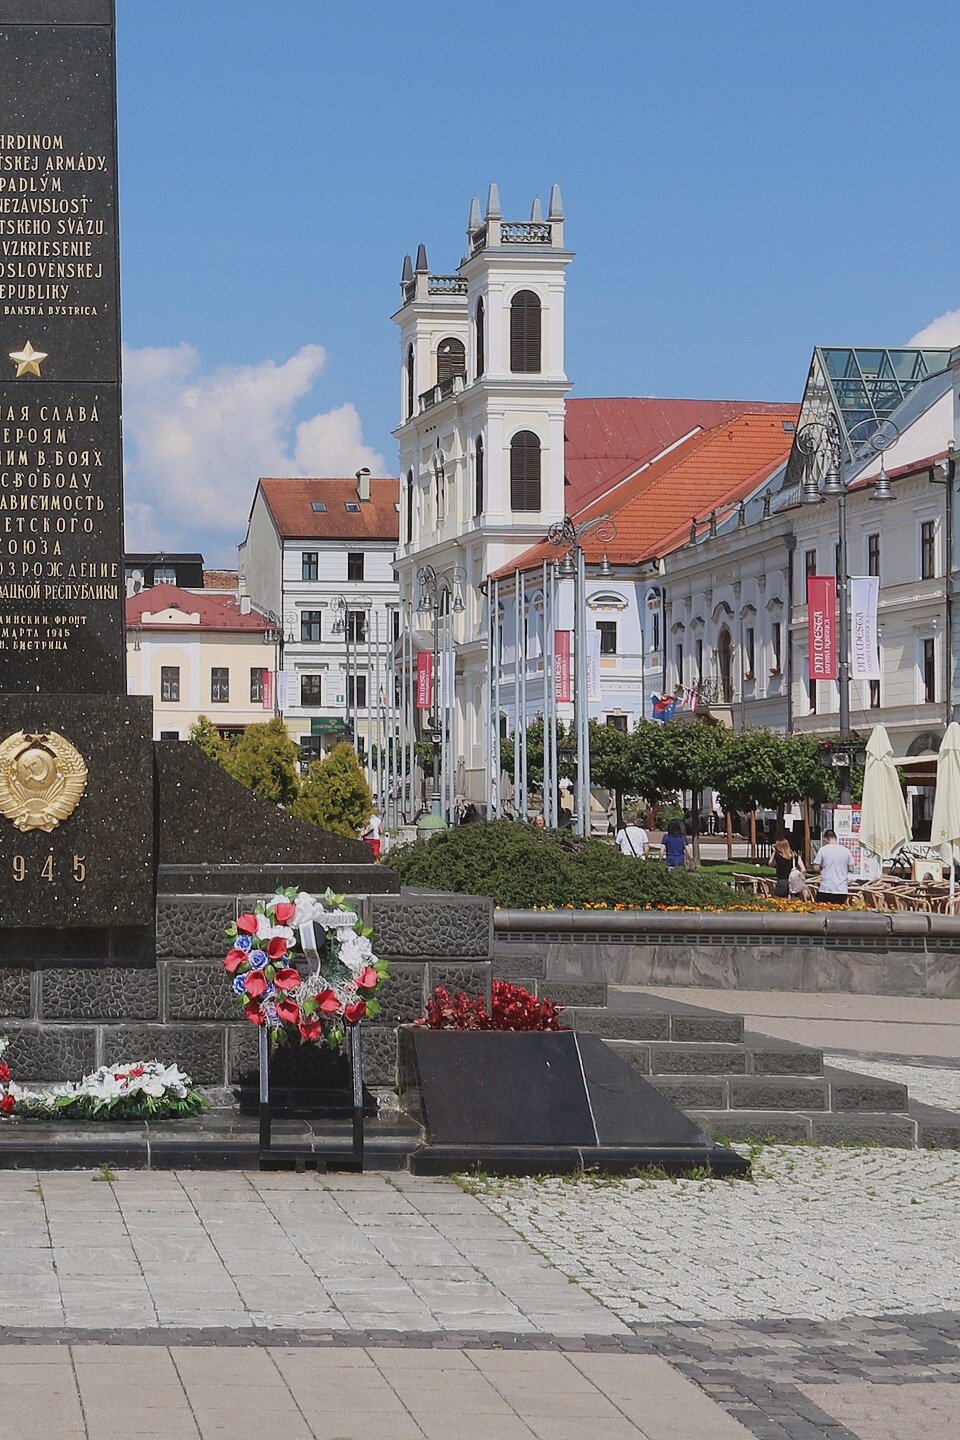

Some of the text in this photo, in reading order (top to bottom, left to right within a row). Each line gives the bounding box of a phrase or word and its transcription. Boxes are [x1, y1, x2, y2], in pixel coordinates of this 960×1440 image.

[45, 152, 108, 172] ARMÁDY,
[2, 241, 92, 257] VZKRIESENIE
[4, 302, 44, 315] BANSKÁ
[48, 306, 98, 316] BYSTRICA
[40, 405, 99, 422] СЛАВА
[37, 451, 46, 466] В
[55, 450, 103, 466] БОЯХ
[1, 472, 92, 489] СВОБОДУ
[44, 583, 118, 600] РЕСПУБЛИКИ
[54, 615, 87, 625] ФРОНТ
[1, 628, 39, 638] МАРТА
[46, 628, 71, 638] 1945
[814, 610, 824, 674] DNI MESTA
[855, 612, 866, 673] DNI MESTA
